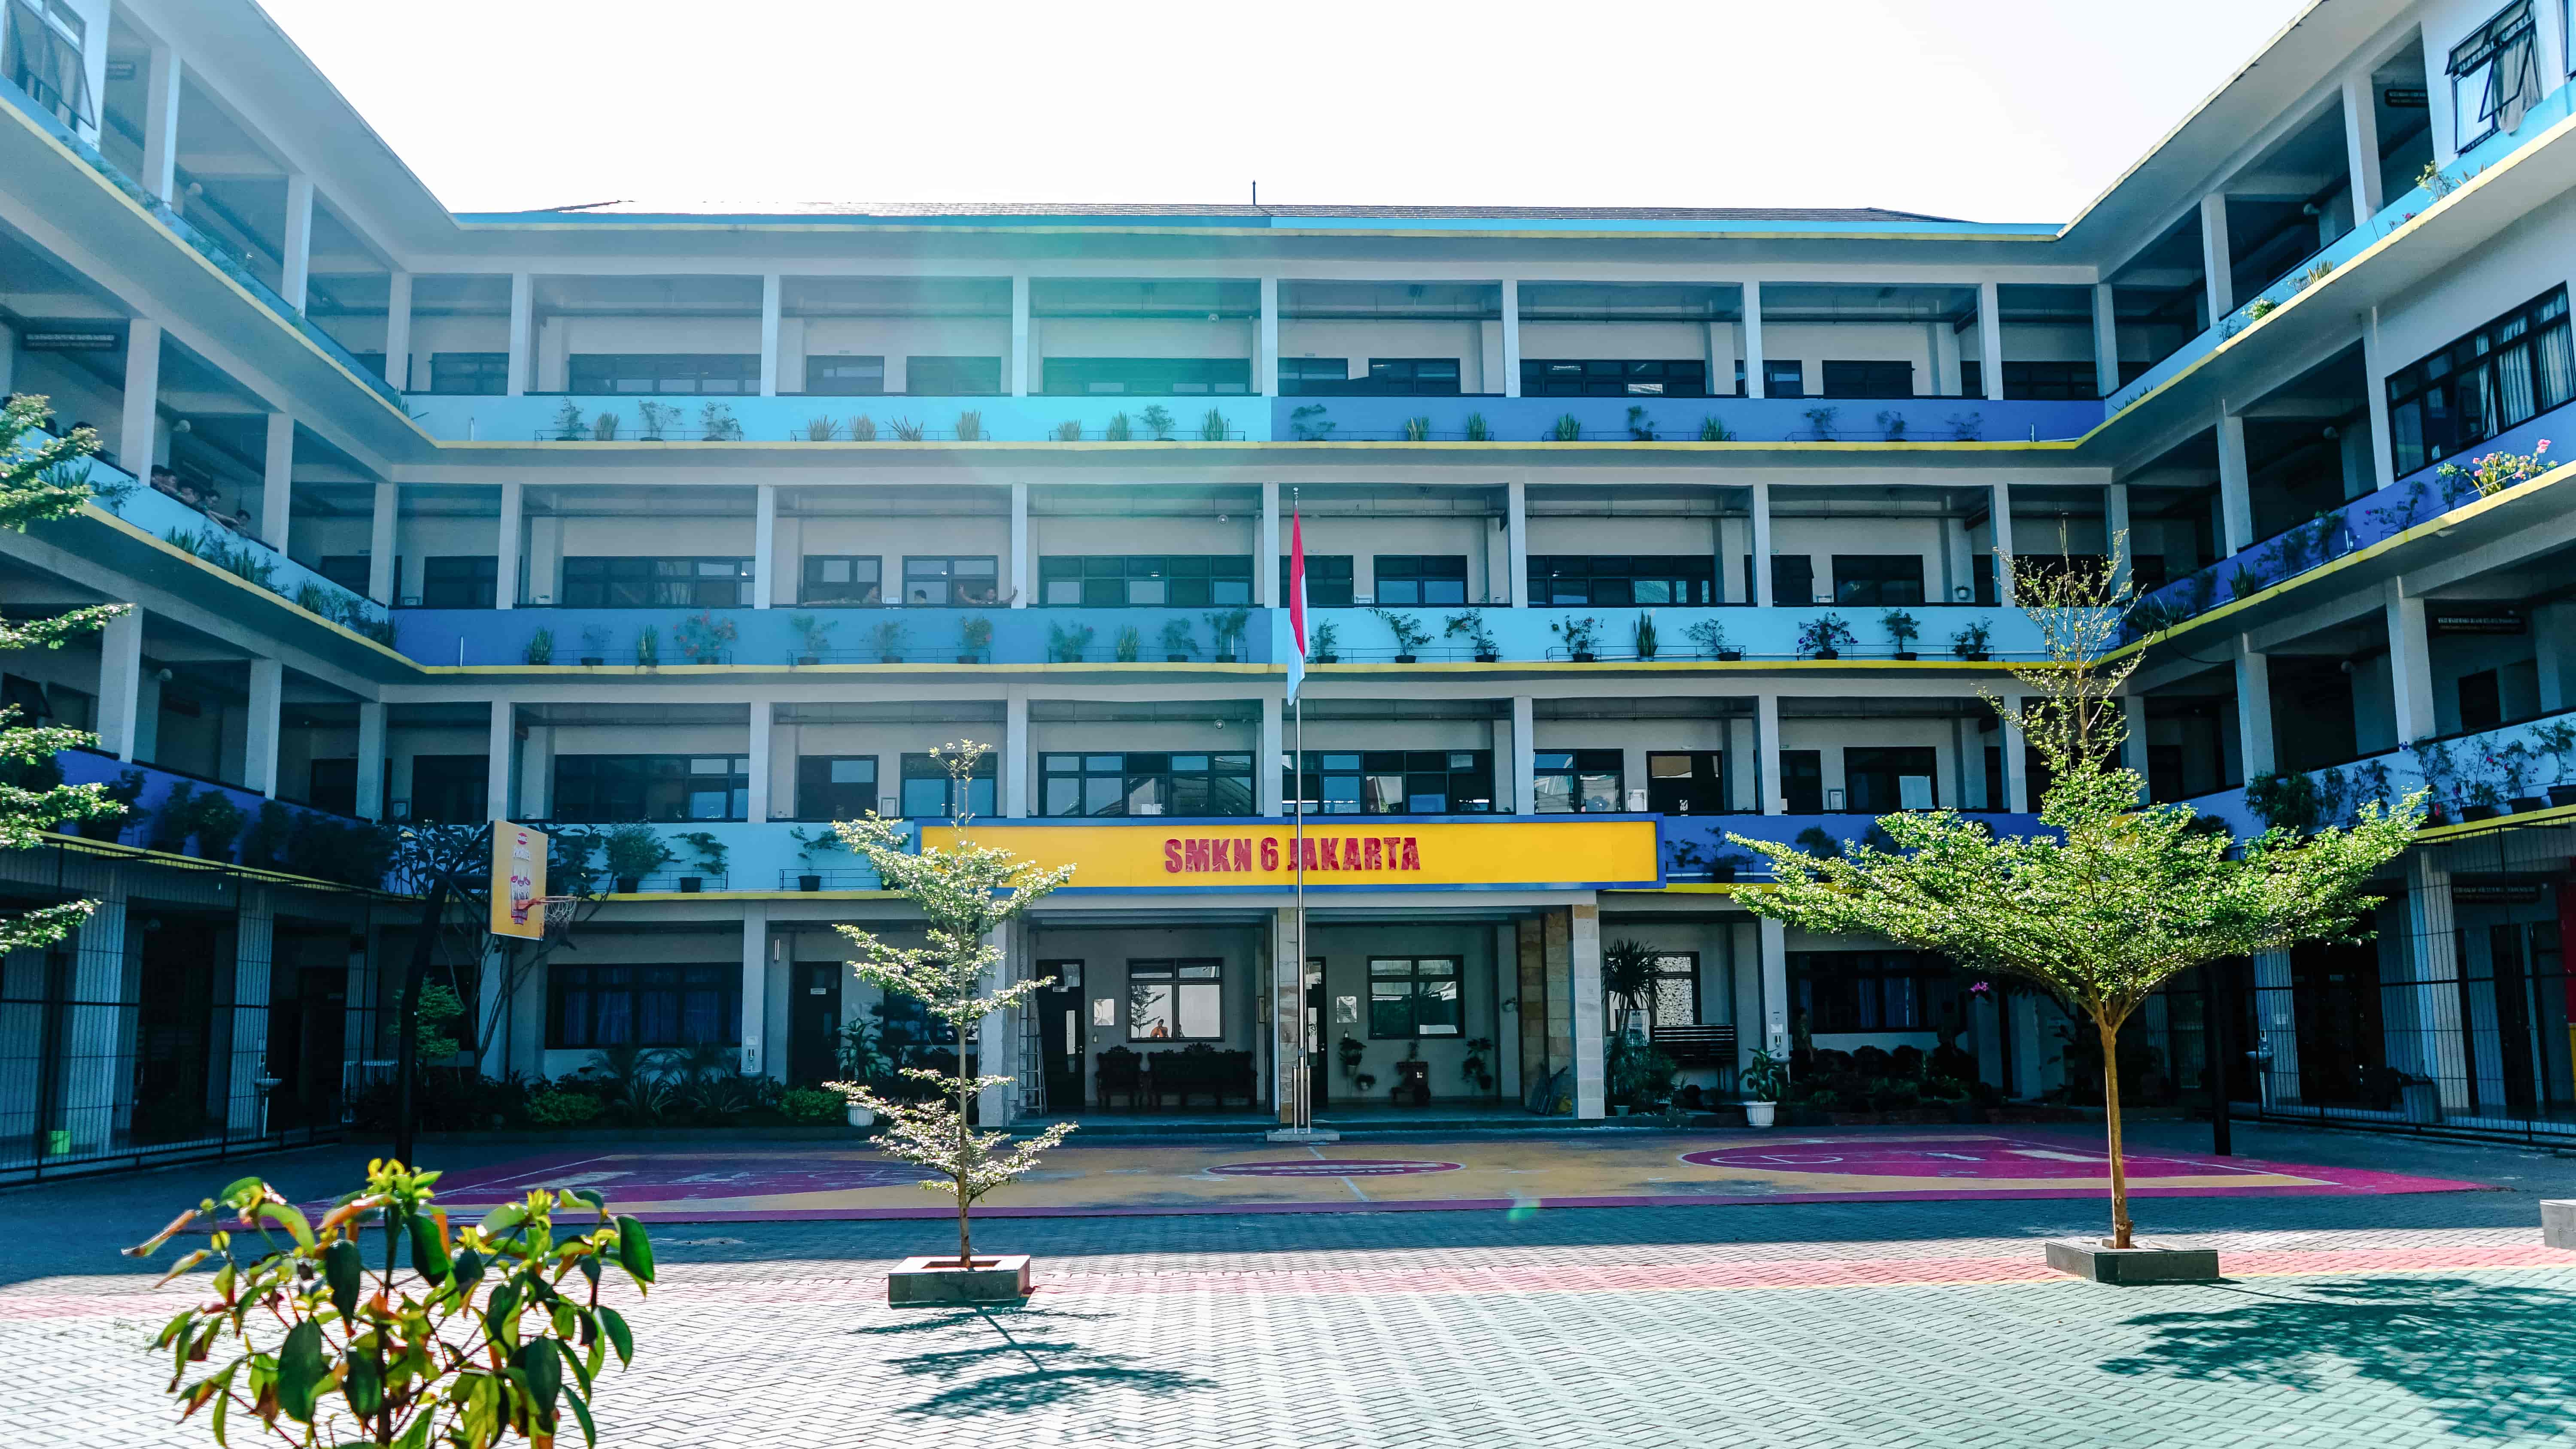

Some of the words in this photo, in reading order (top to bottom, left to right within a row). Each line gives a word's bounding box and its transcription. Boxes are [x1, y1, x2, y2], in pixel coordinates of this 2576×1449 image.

[1165, 839, 1252, 873] SMKN
[1261, 837, 1279, 871] 6
[1287, 837, 1421, 871] JAKARTA
